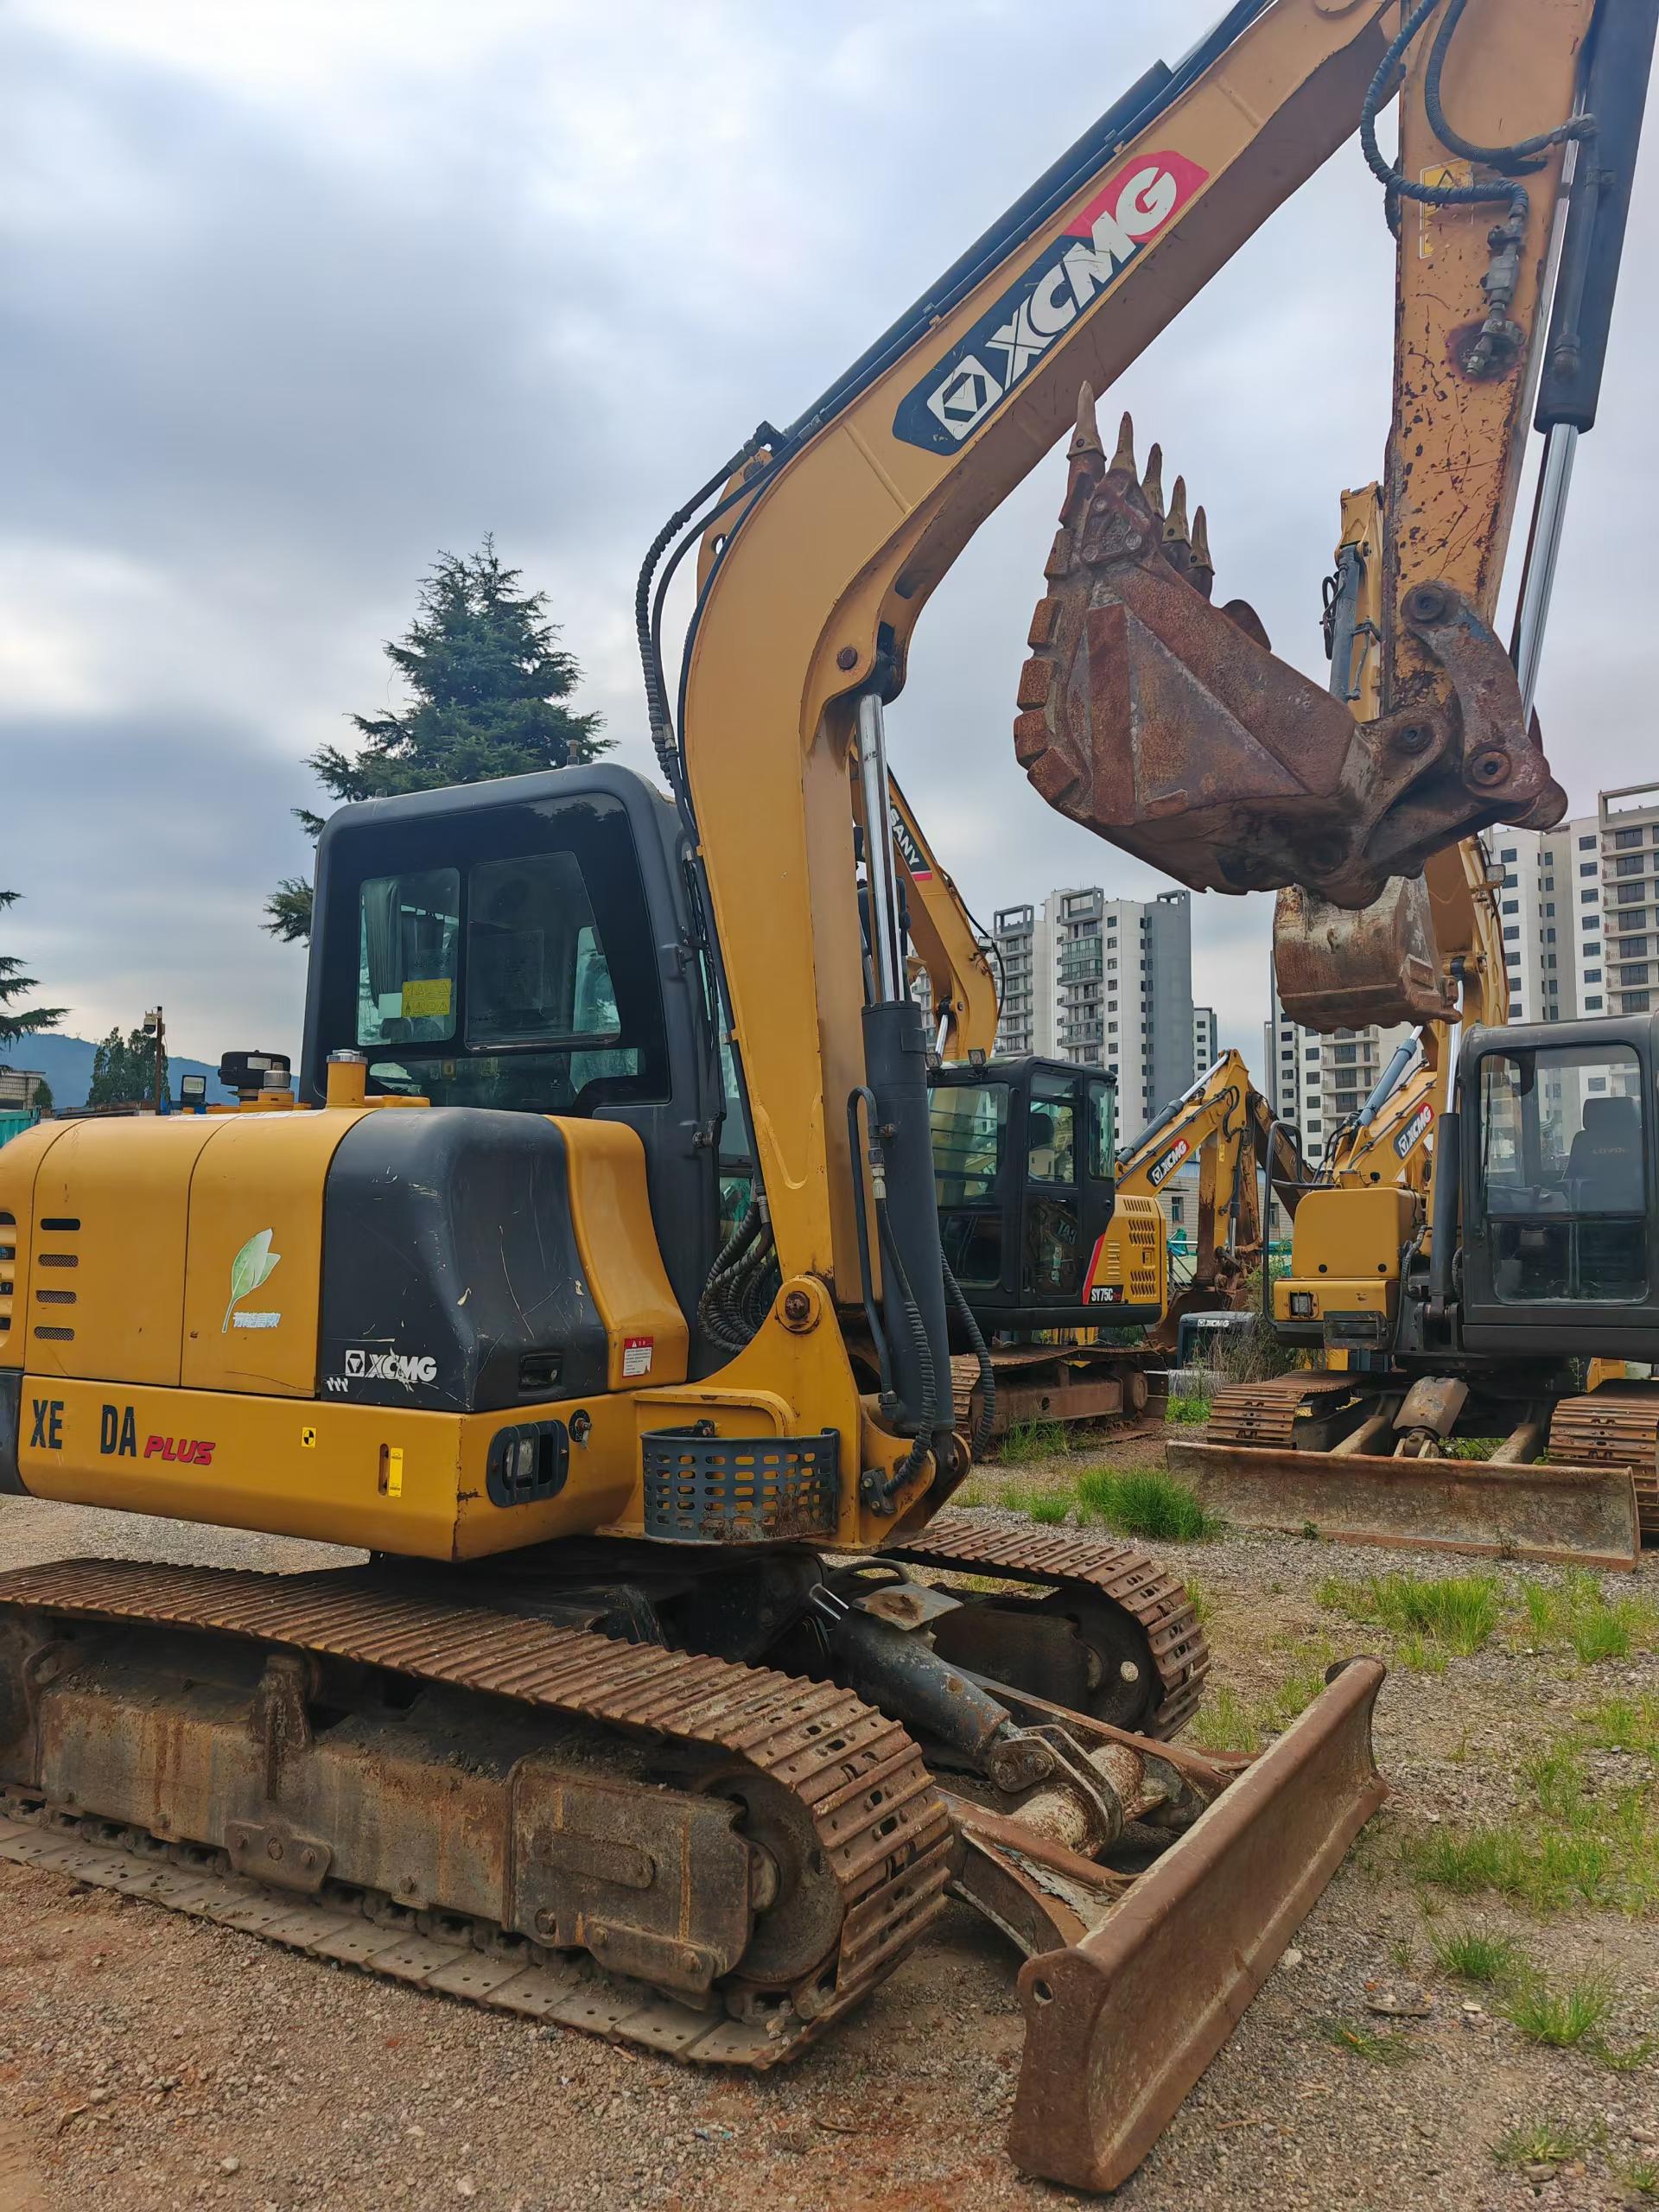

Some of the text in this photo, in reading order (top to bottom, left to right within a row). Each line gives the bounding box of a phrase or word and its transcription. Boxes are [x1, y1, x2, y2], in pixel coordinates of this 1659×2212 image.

[984, 167, 1177, 391] XCMG
[890, 808, 920, 866] SANY
[1405, 1105, 1432, 1148] XCMG
[1160, 1140, 1187, 1176] XCMG
[1091, 1287, 1114, 1302] SY75C
[364, 1353, 437, 1382] XCMG
[30, 1399, 216, 1466] XE DA PLUS
